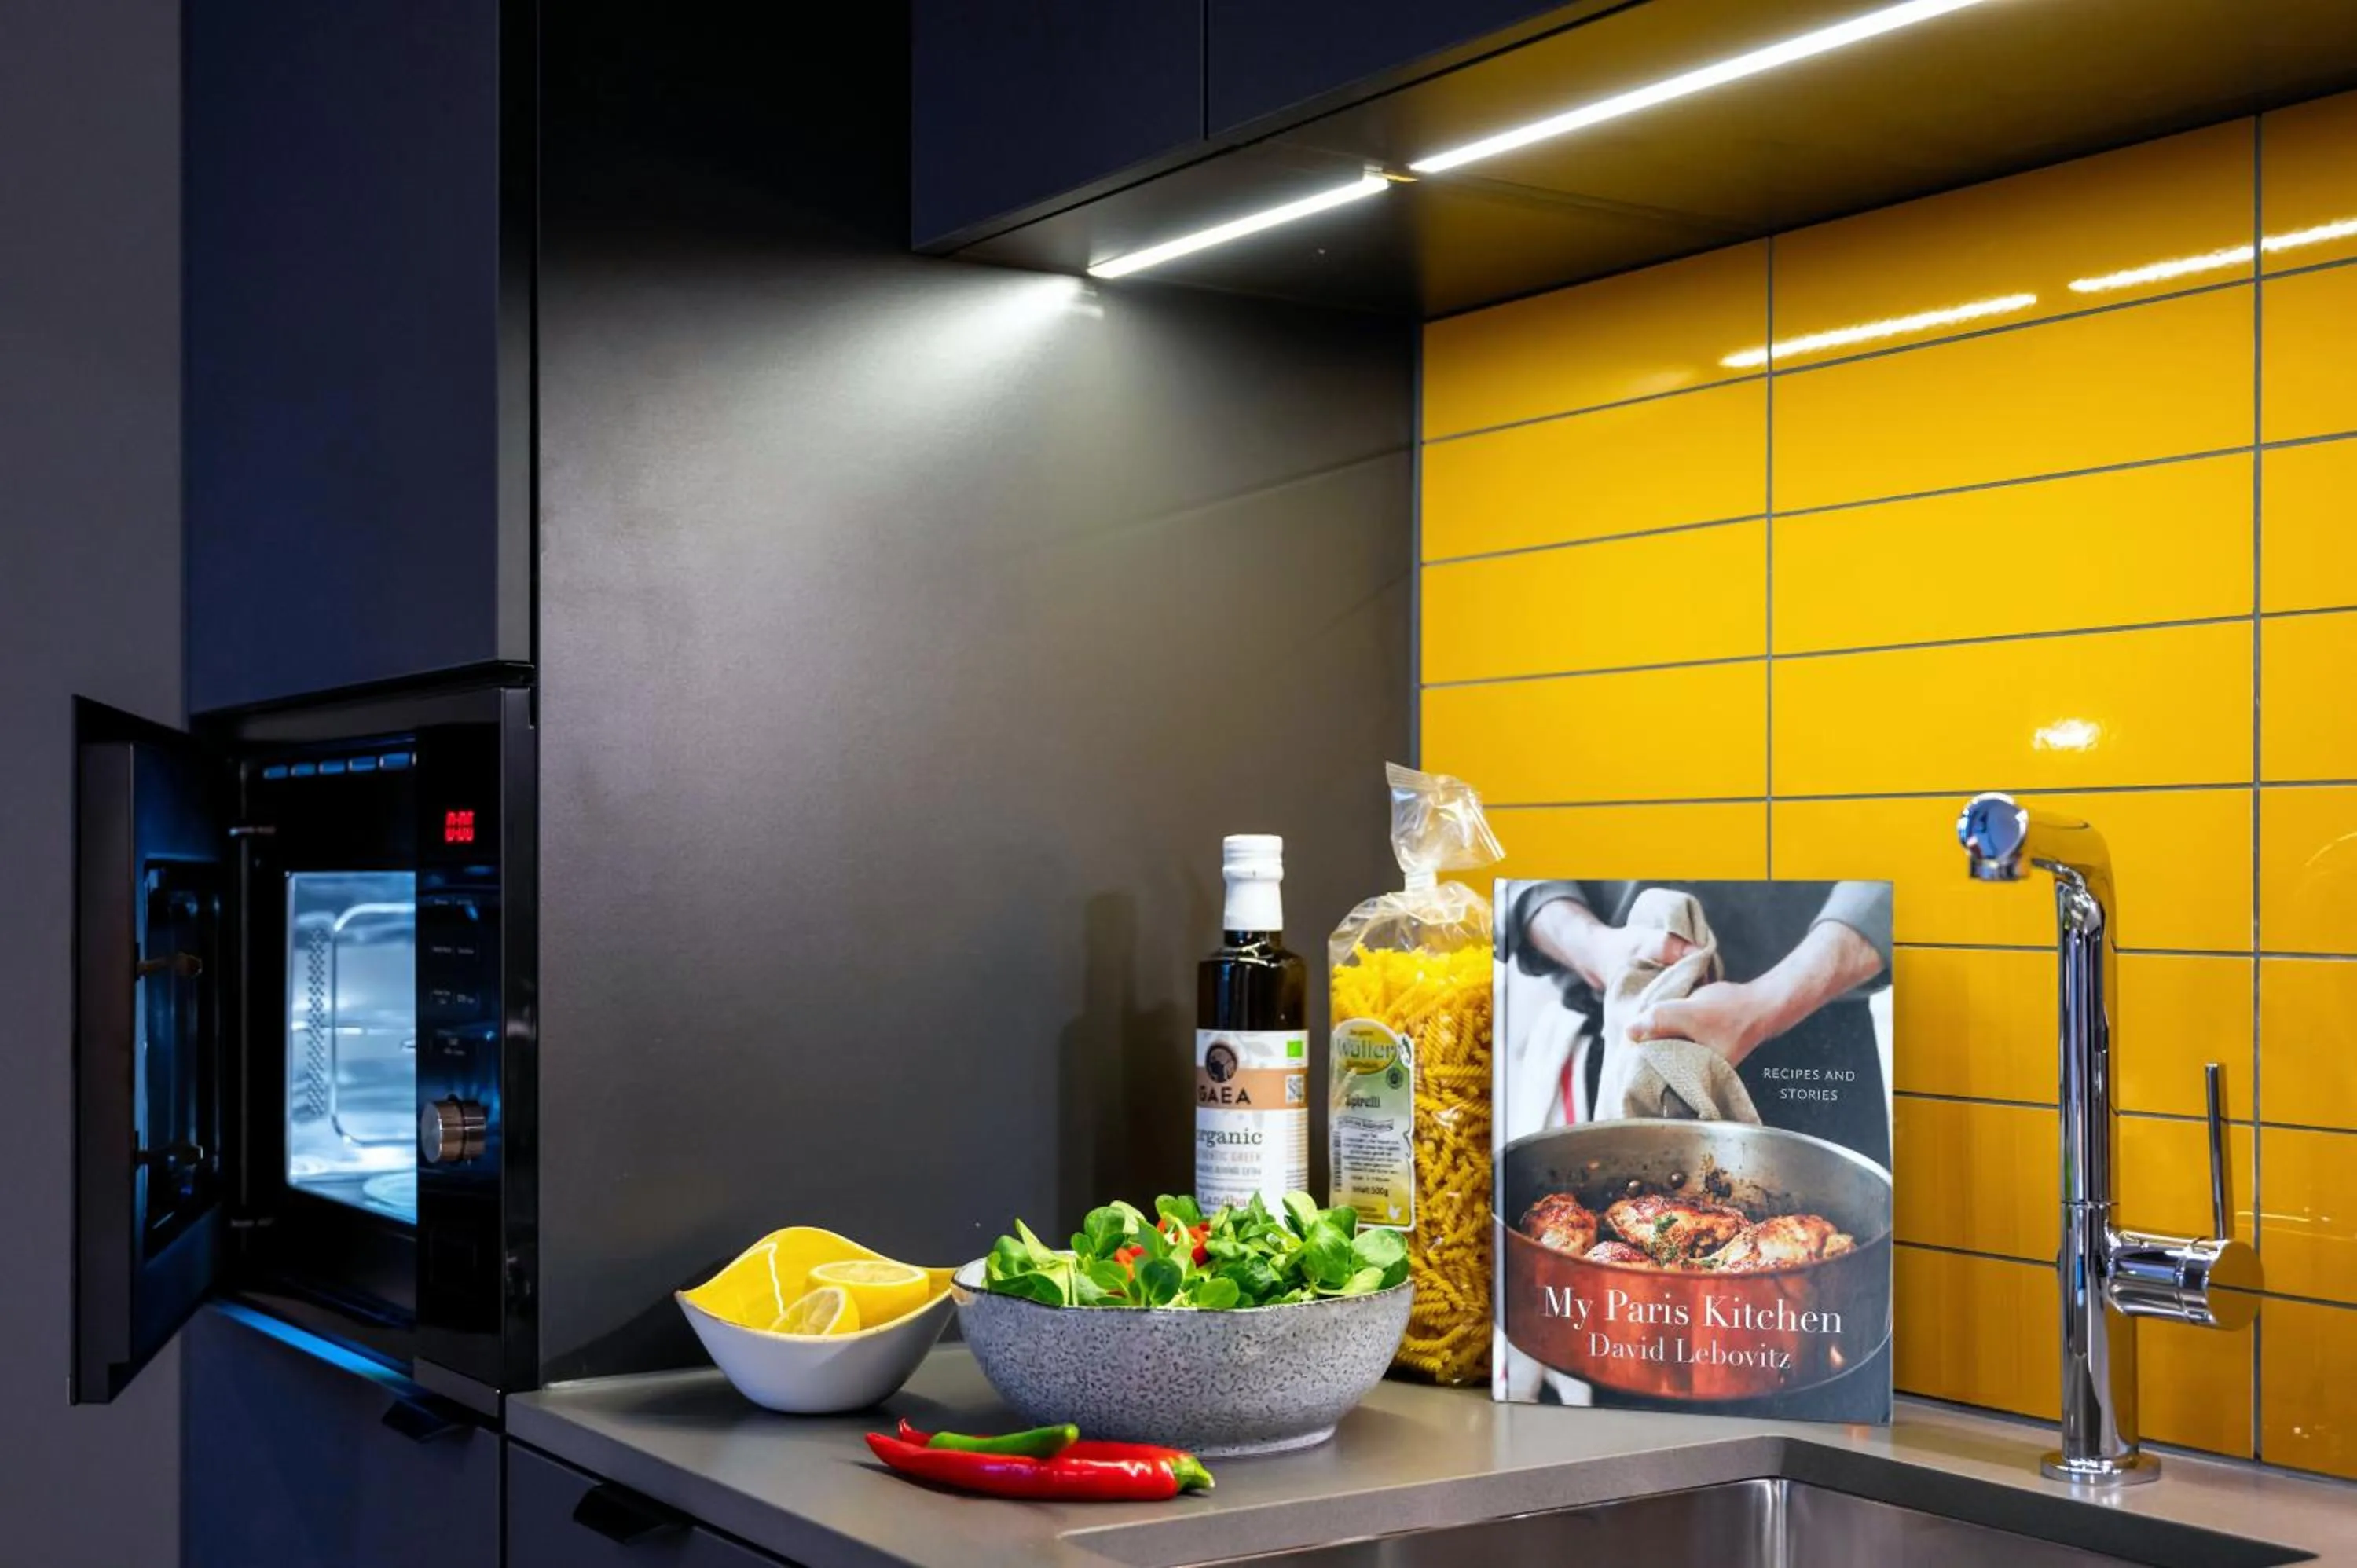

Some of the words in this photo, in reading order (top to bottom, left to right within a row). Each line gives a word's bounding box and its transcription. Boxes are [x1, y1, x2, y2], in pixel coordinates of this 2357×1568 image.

[1763, 1068, 1820, 1080] RECIPES
[1824, 1070, 1856, 1082] AND
[1198, 1085, 1252, 1105] GAEA
[1779, 1088, 1838, 1101] STORIES
[1196, 1127, 1263, 1149] rganic
[1544, 1286, 1596, 1330] My
[1604, 1289, 1690, 1325] Paris
[1703, 1295, 1843, 1334] Kitchen
[1587, 1332, 1665, 1361] David
[1675, 1338, 1792, 1369] Lebovitz
